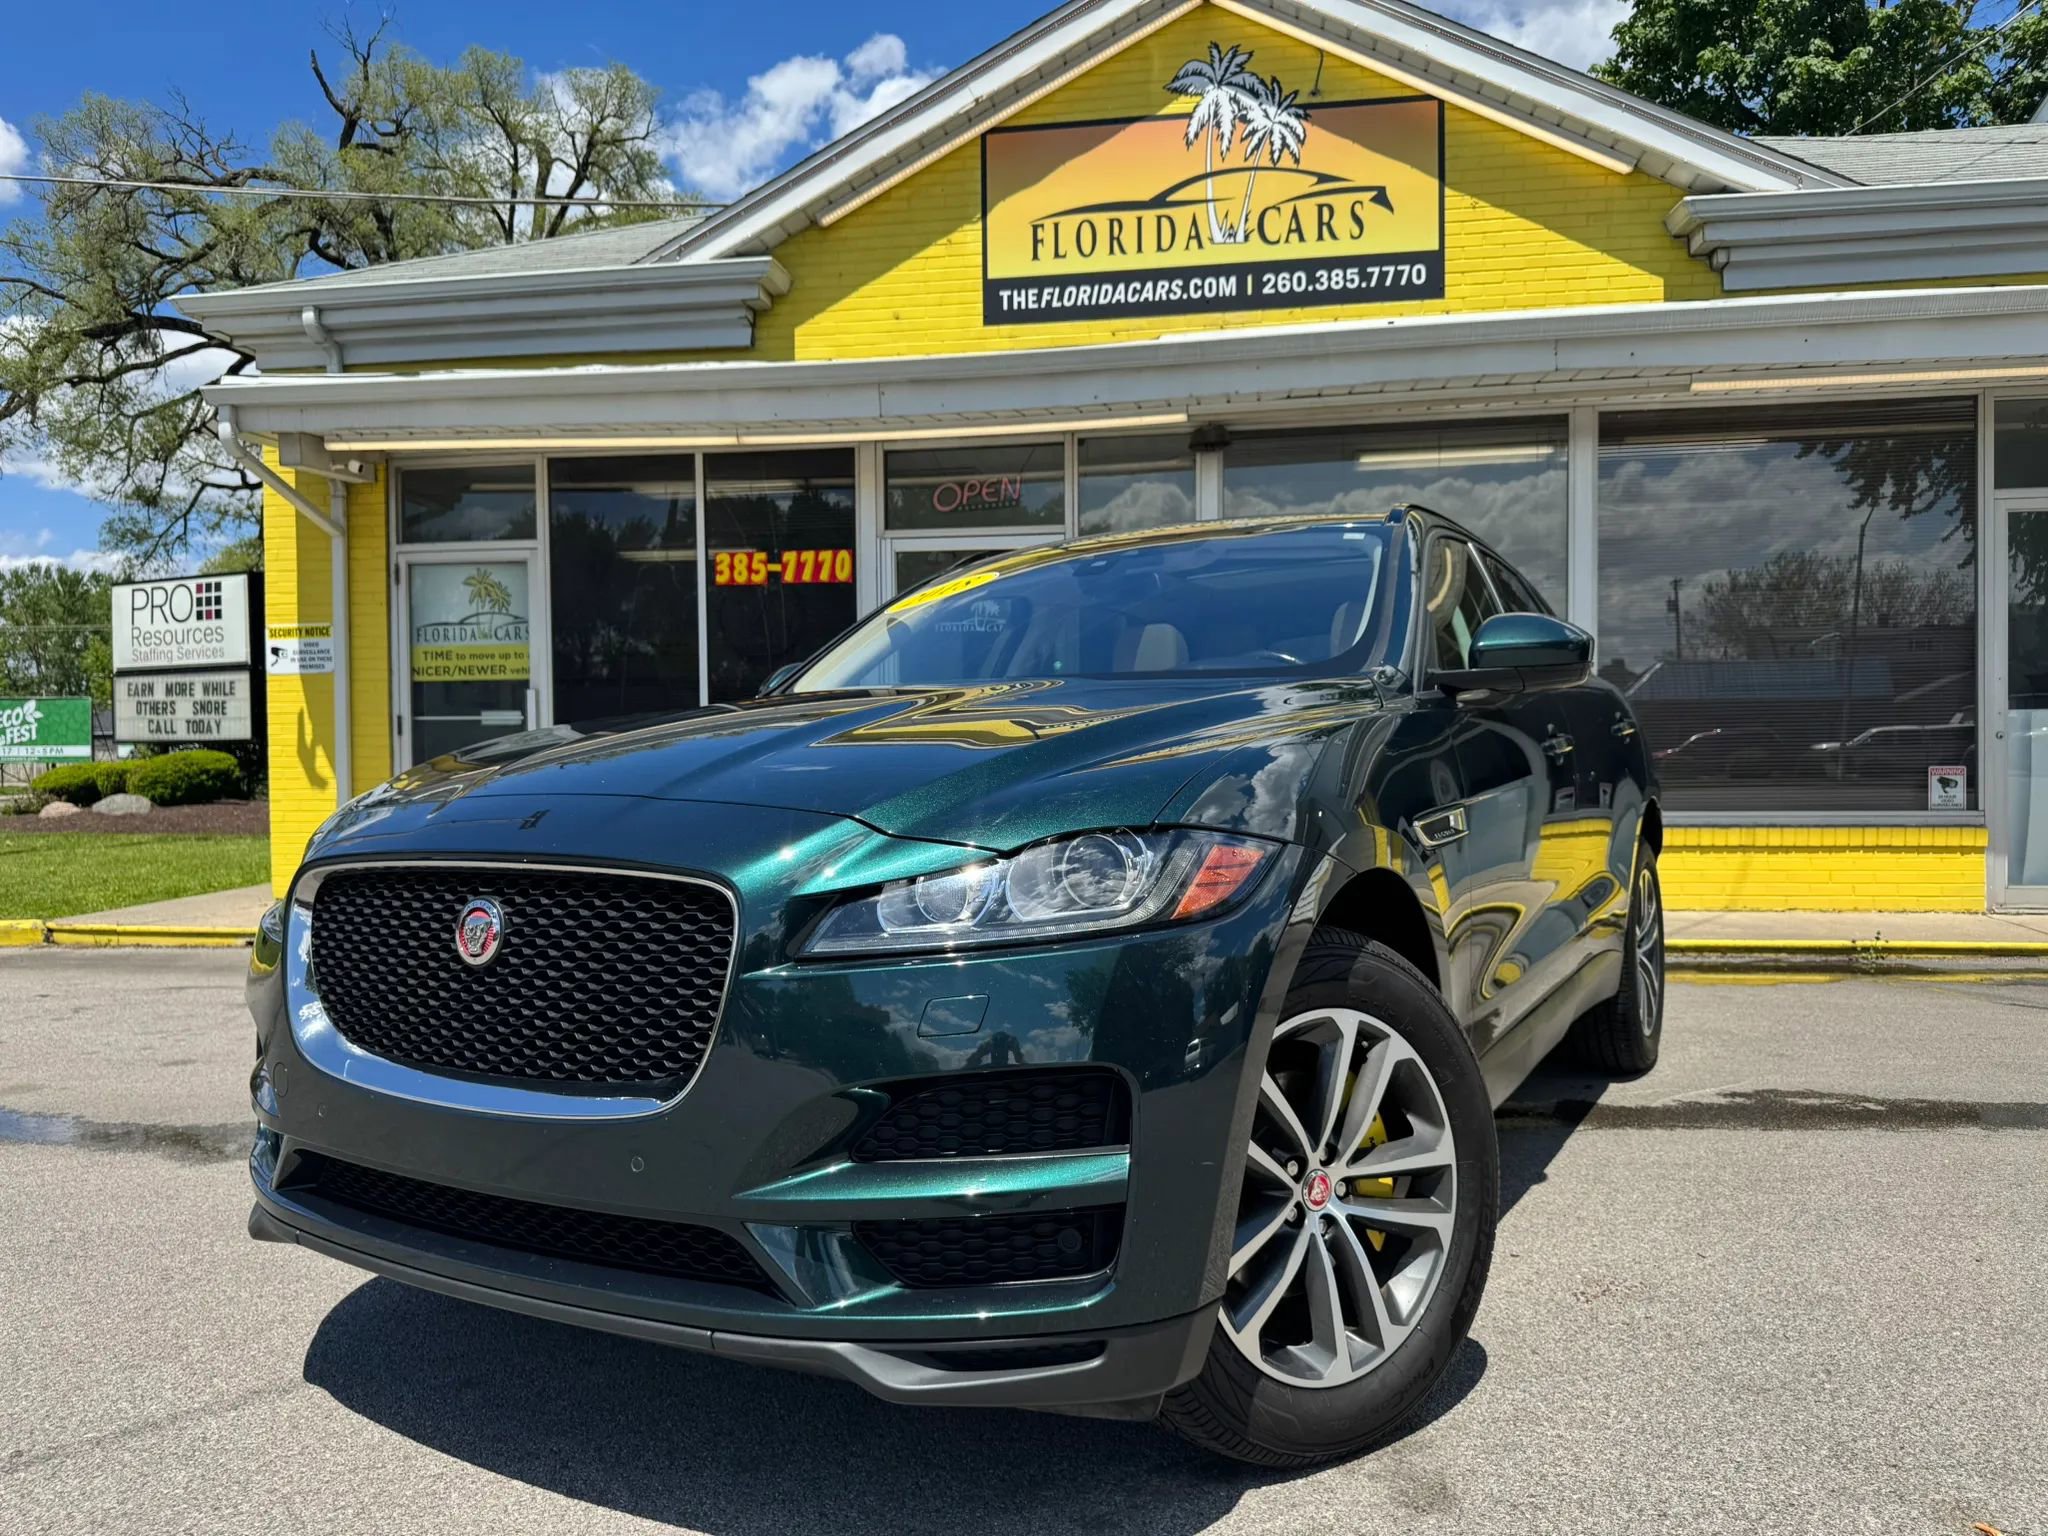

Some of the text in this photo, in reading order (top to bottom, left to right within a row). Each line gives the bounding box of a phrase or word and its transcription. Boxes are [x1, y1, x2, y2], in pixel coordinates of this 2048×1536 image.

[1031, 200, 1365, 262] FLORIDA CARS
[1000, 263, 1426, 311] THEFLORIDACARS.COM 260.385.7770
[933, 475, 1020, 512] OPEN
[715, 549, 851, 585] 385-7770
[131, 583, 194, 625] PRO
[131, 626, 224, 648] Resources
[269, 626, 331, 639] SECURITY NOTICE
[415, 626, 479, 642] FLORIDA
[132, 645, 224, 664] Staffing Services
[422, 650, 525, 662] TIME to move up to
[412, 664, 507, 677] NICER/NEWER
[127, 680, 236, 697] EARN MORE WHILE
[135, 700, 227, 716] OTHERS SNORE
[148, 719, 221, 734] CALL TODAY
[1930, 768, 1965, 776] WARNING
